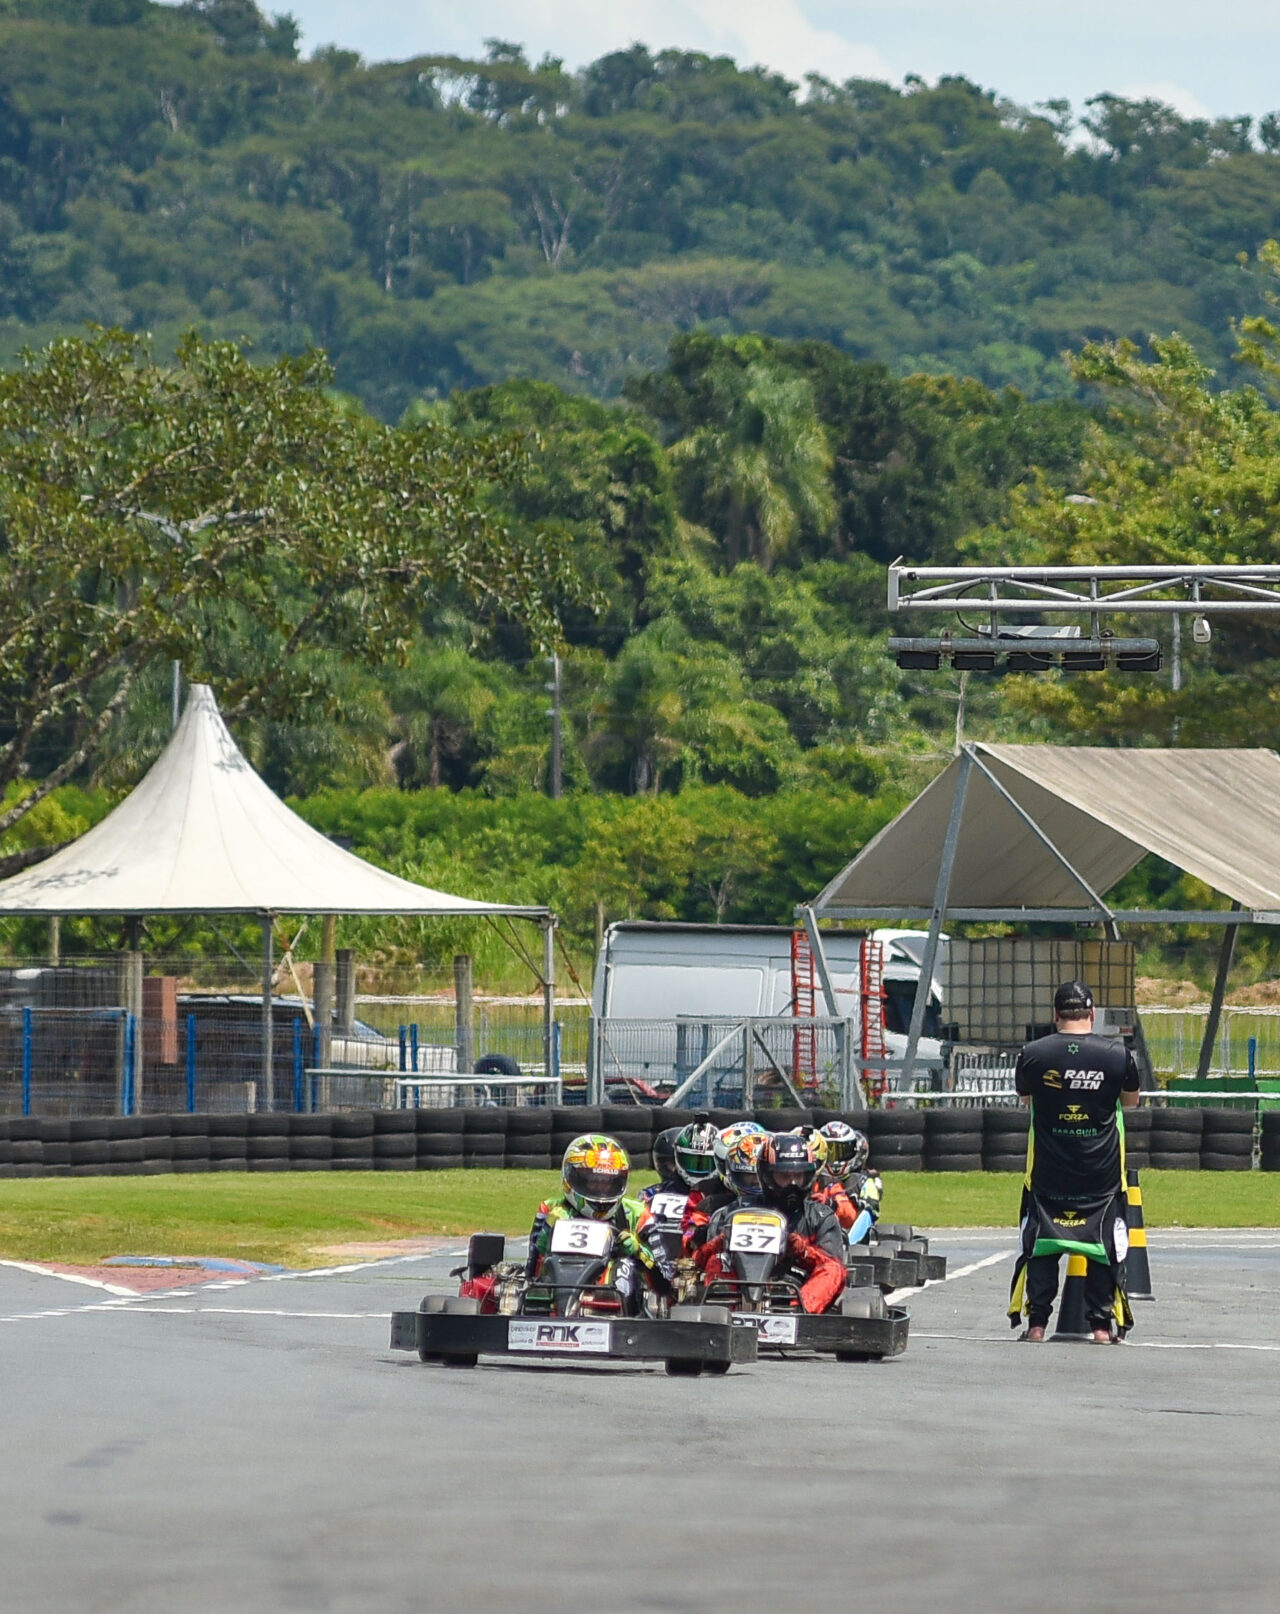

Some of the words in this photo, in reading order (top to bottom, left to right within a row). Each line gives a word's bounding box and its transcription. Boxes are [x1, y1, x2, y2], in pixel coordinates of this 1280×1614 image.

[1064, 1070, 1105, 1081] RAFA
[1069, 1080, 1102, 1090] BIN
[1058, 1113, 1090, 1121] FORZA
[657, 1203, 686, 1216] 16
[568, 1231, 589, 1249] 3
[734, 1233, 776, 1249] 37
